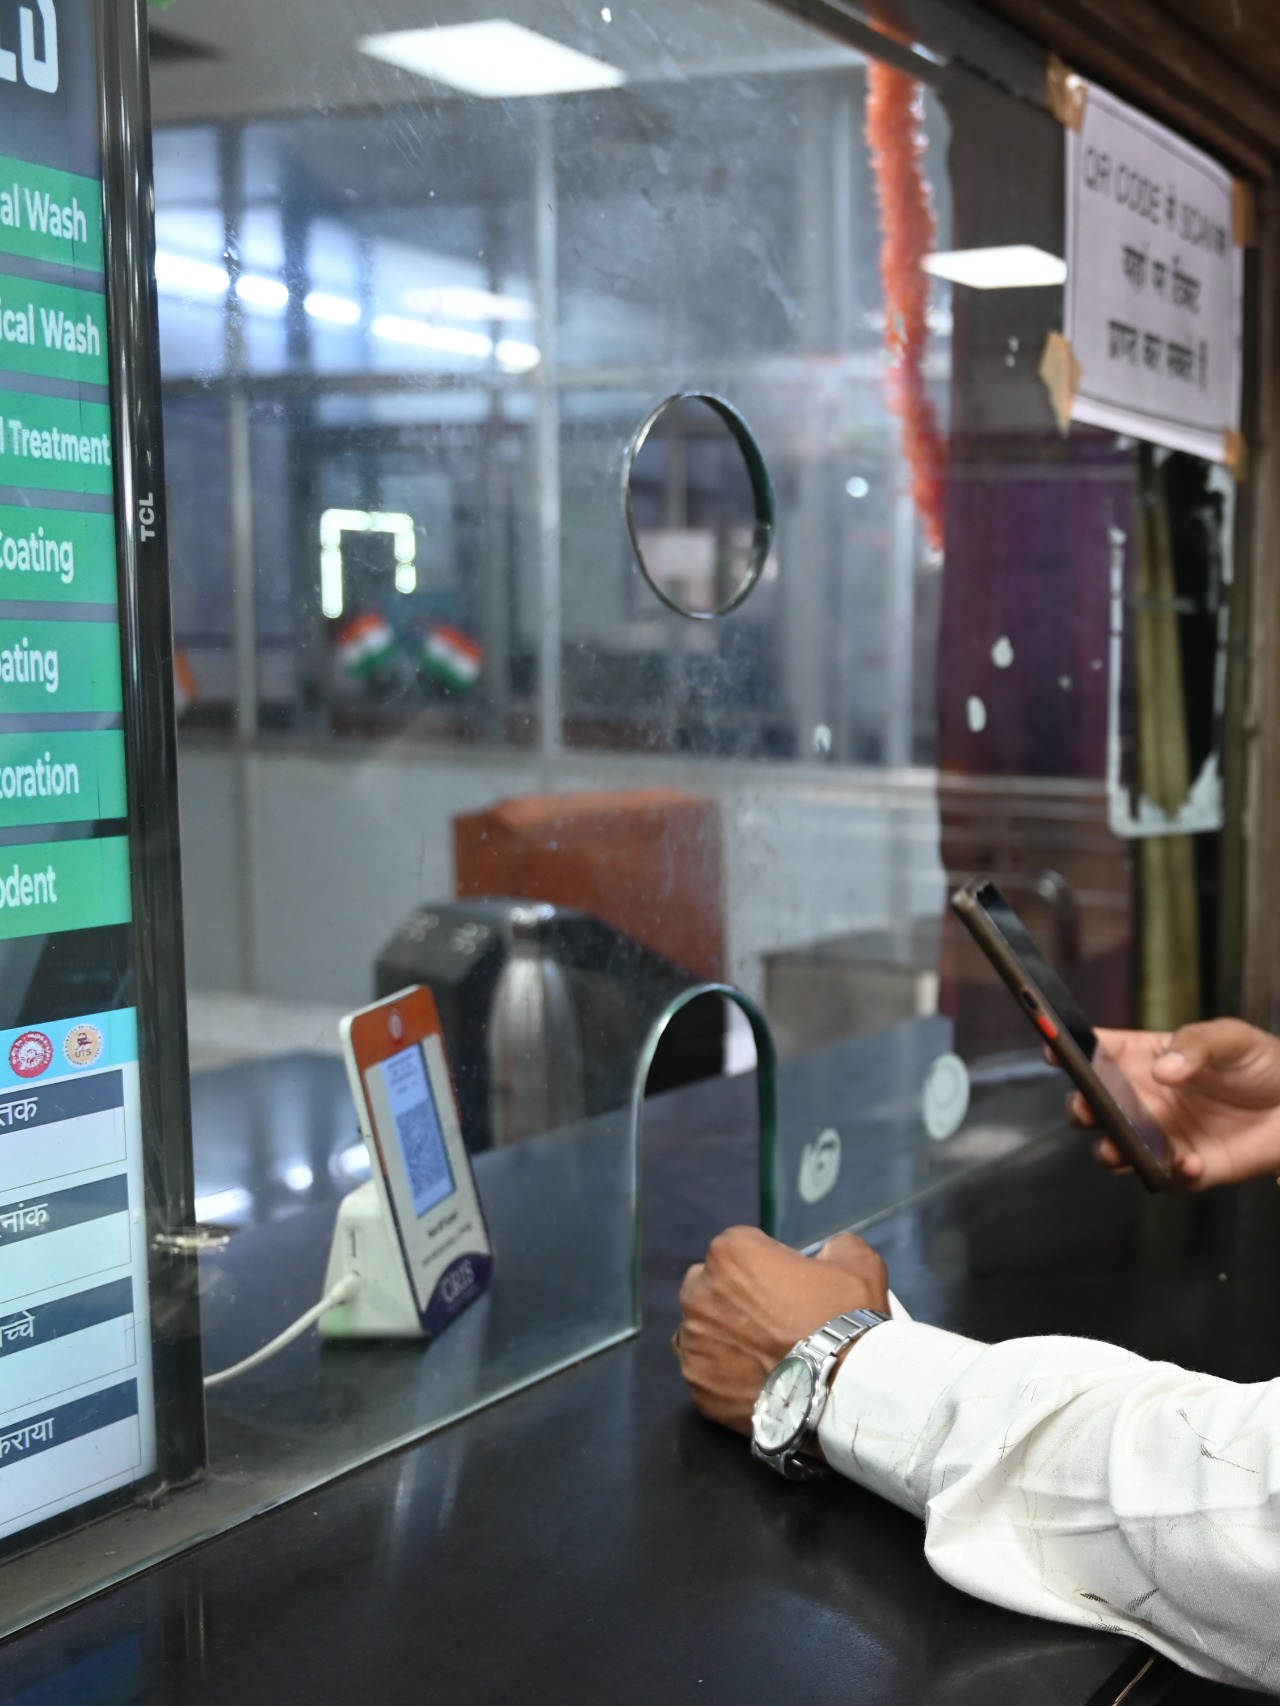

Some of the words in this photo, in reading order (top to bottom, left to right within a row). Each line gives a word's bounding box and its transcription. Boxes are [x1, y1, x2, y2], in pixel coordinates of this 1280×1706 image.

[25, 188, 88, 244] Wash
[1115, 163, 1161, 226] CODE
[40, 308, 100, 356] Wash
[9, 419, 111, 466] Treatment
[138, 492, 155, 542] TCL
[0, 526, 74, 584] oating
[0, 636, 59, 693] ating
[0, 751, 80, 799] oration
[75, 1048, 92, 1059] UTS
[0, 1202, 48, 1238] नांक
[0, 1311, 35, 1347] च्चे
